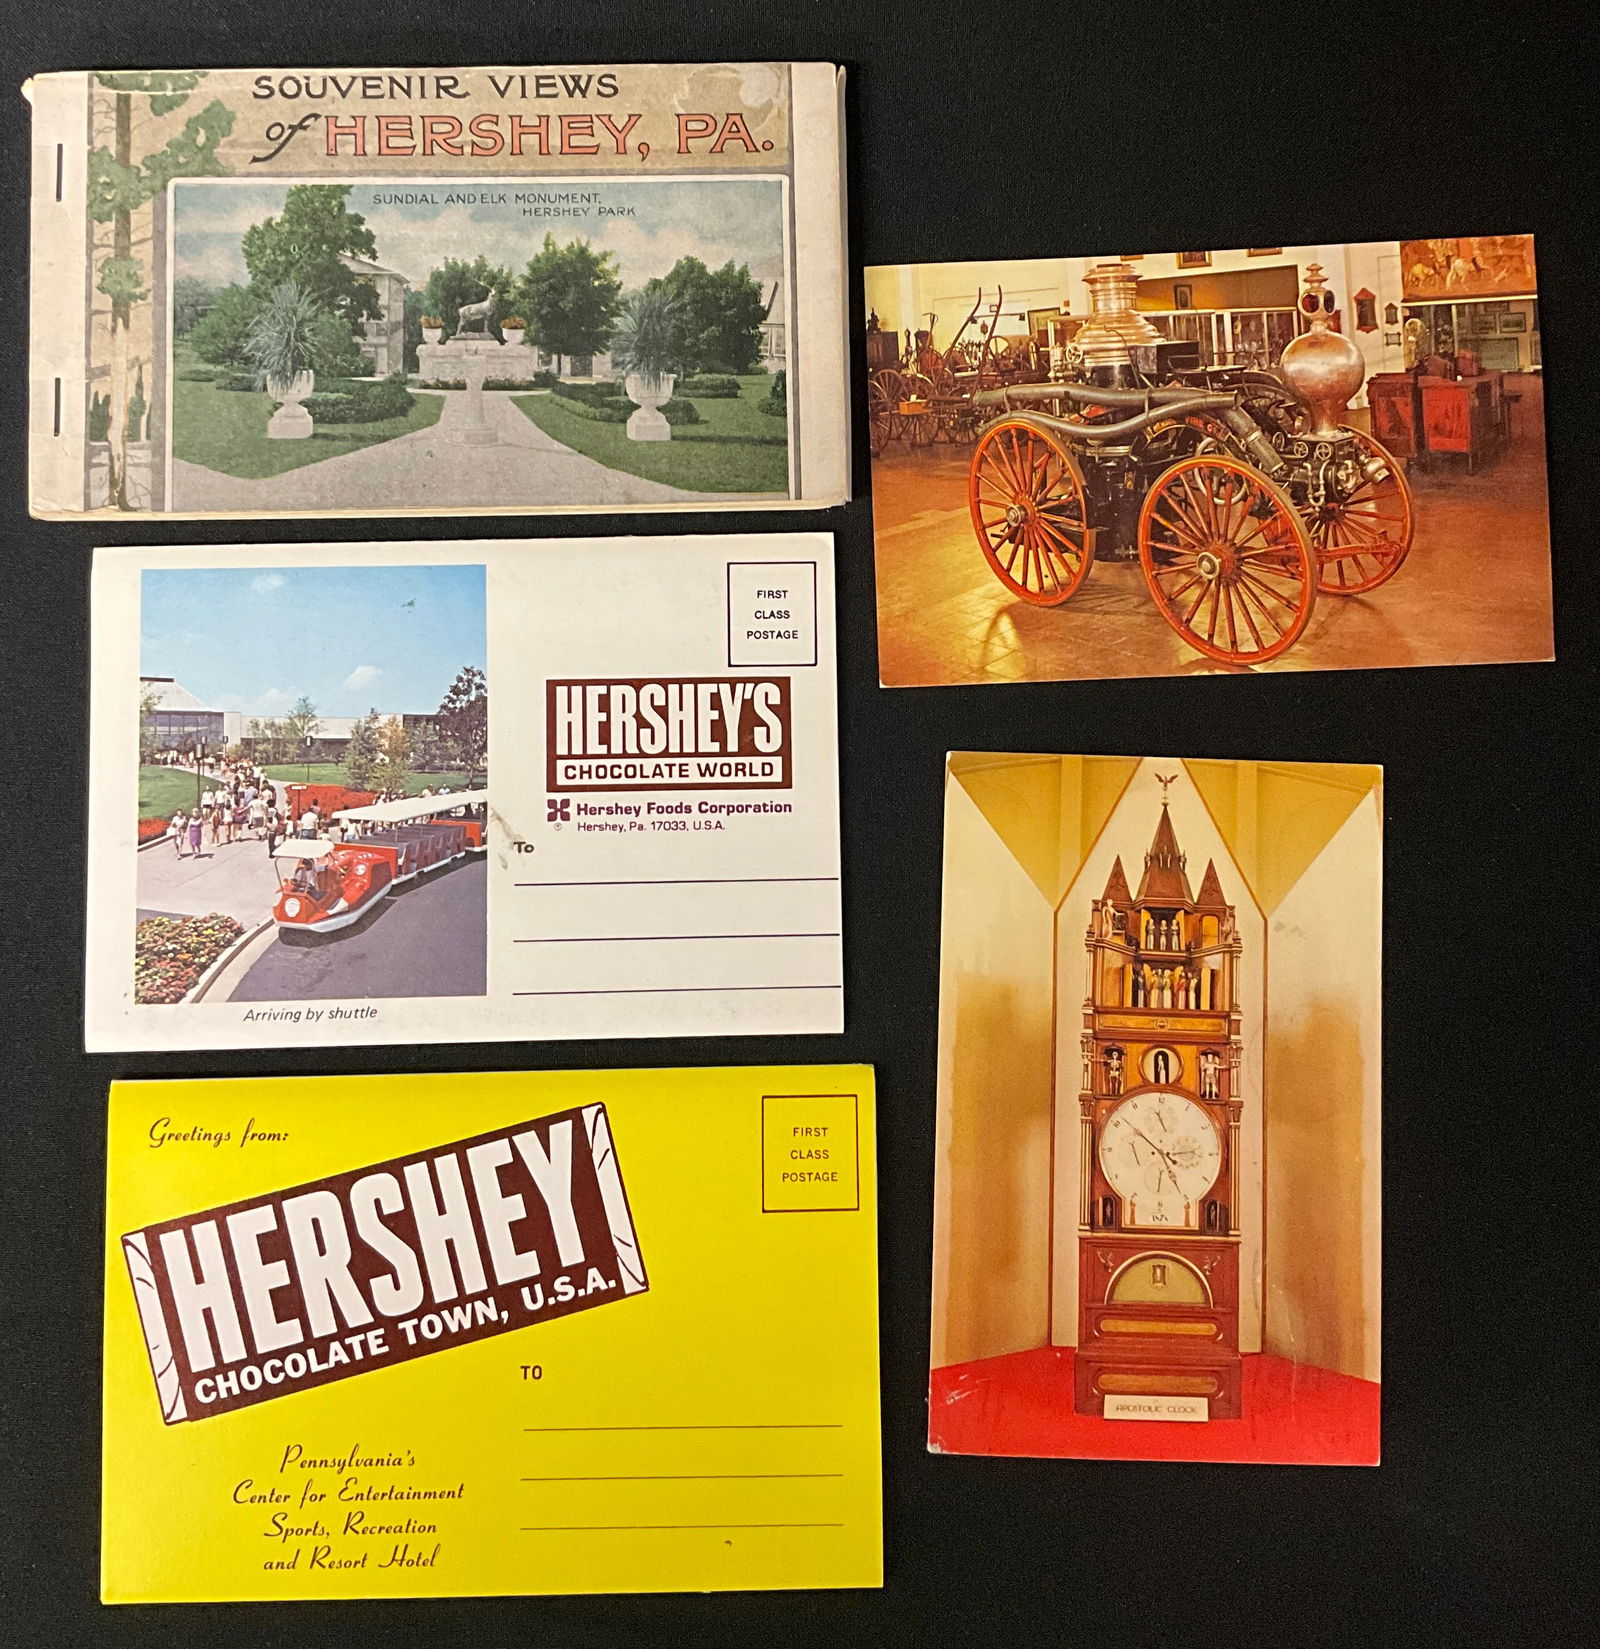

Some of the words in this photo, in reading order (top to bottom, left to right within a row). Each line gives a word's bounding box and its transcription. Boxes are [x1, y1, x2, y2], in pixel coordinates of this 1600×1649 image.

[252, 75, 471, 100] SOUVENIR
[487, 73, 619, 99] VIEWS
[248, 112, 322, 164] of
[324, 113, 650, 162] HERSHEY,
[675, 112, 774, 154] PA.
[372, 193, 439, 205] SUNDIAL
[444, 193, 477, 205] AND
[480, 193, 507, 204] ELK
[522, 207, 590, 217] HERSHEY
[598, 206, 636, 216] PARK
[756, 589, 789, 600] FIRST
[753, 609, 791, 620] CLASS
[746, 629, 799, 640] POSTAGE
[555, 682, 783, 755] HERSHEY'S
[563, 763, 690, 780] CHOCOLATE
[697, 761, 774, 778] WORLD
[576, 802, 642, 818] Hershey
[647, 801, 693, 815] Foods
[698, 800, 793, 816] Corporation
[577, 821, 627, 834] Hershey,
[629, 821, 647, 832] Pa.
[651, 820, 689, 832] 17033,
[692, 819, 726, 831] U.S.A.
[513, 841, 535, 854] To
[243, 1007, 302, 1023] Arriving
[305, 1007, 324, 1022] by
[328, 1006, 378, 1020] shuttle
[149, 1117, 231, 1149] Greetings
[240, 1117, 289, 1148] from:
[792, 1127, 828, 1137] FIRST
[790, 1149, 830, 1160] CLASS
[782, 1171, 838, 1182] POSTAGE
[159, 1119, 586, 1373] HERSHEY
[194, 1327, 390, 1404] CHOCOLATE
[399, 1297, 510, 1346] TOWN,
[522, 1267, 616, 1312] U.S.A.
[520, 1365, 543, 1381] TO
[1116, 1404, 1163, 1413] APOSTOLIC
[1167, 1405, 1197, 1414] CLOCK
[279, 1443, 416, 1474] Pennsylvania's
[233, 1479, 291, 1504] Center
[299, 1478, 327, 1509] for
[338, 1477, 465, 1502] Entertainment
[263, 1512, 331, 1543] Sports,
[343, 1510, 438, 1535] Recreation
[263, 1548, 301, 1570] and
[309, 1545, 368, 1570] Resort
[378, 1543, 442, 1568] Hotel
